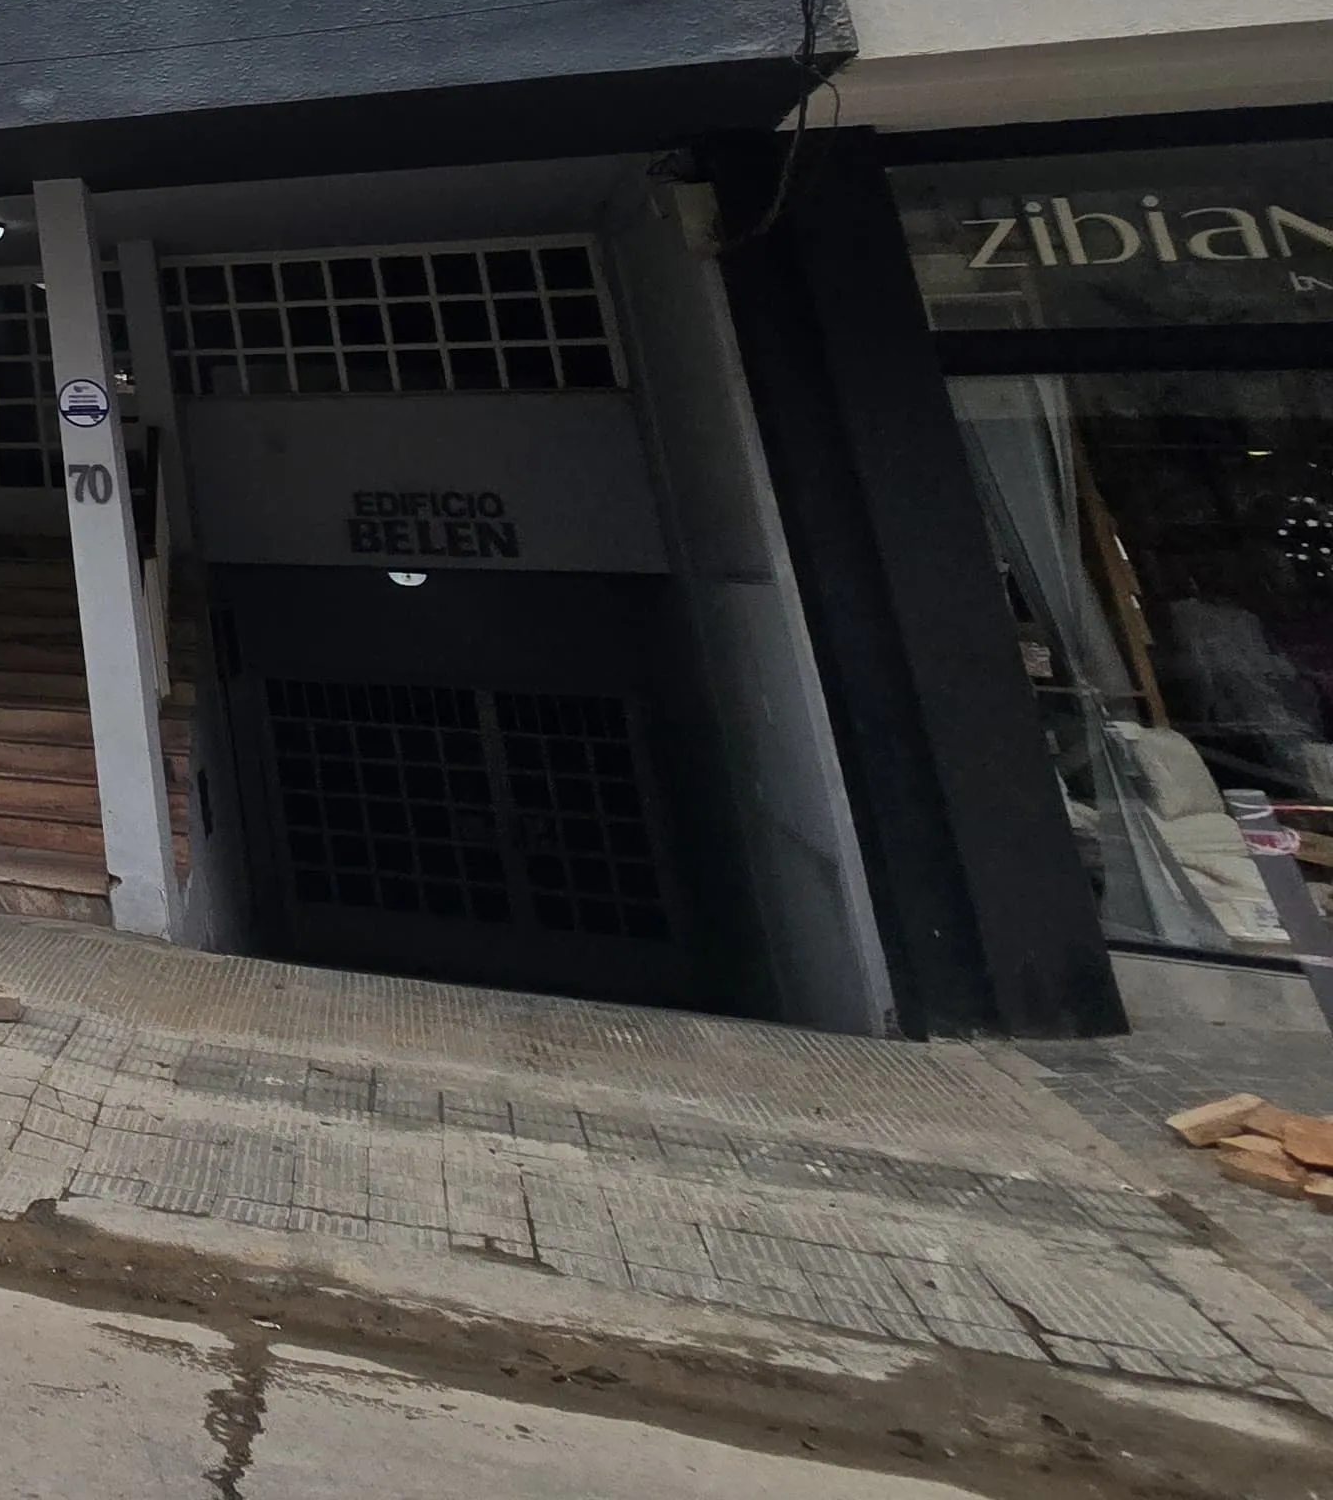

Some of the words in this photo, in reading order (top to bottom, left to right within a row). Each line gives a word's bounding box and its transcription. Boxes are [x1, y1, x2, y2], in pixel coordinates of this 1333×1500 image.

[68, 463, 113, 505] 70
[352, 490, 505, 518] EDIFICIO
[347, 518, 520, 558] BELEN
